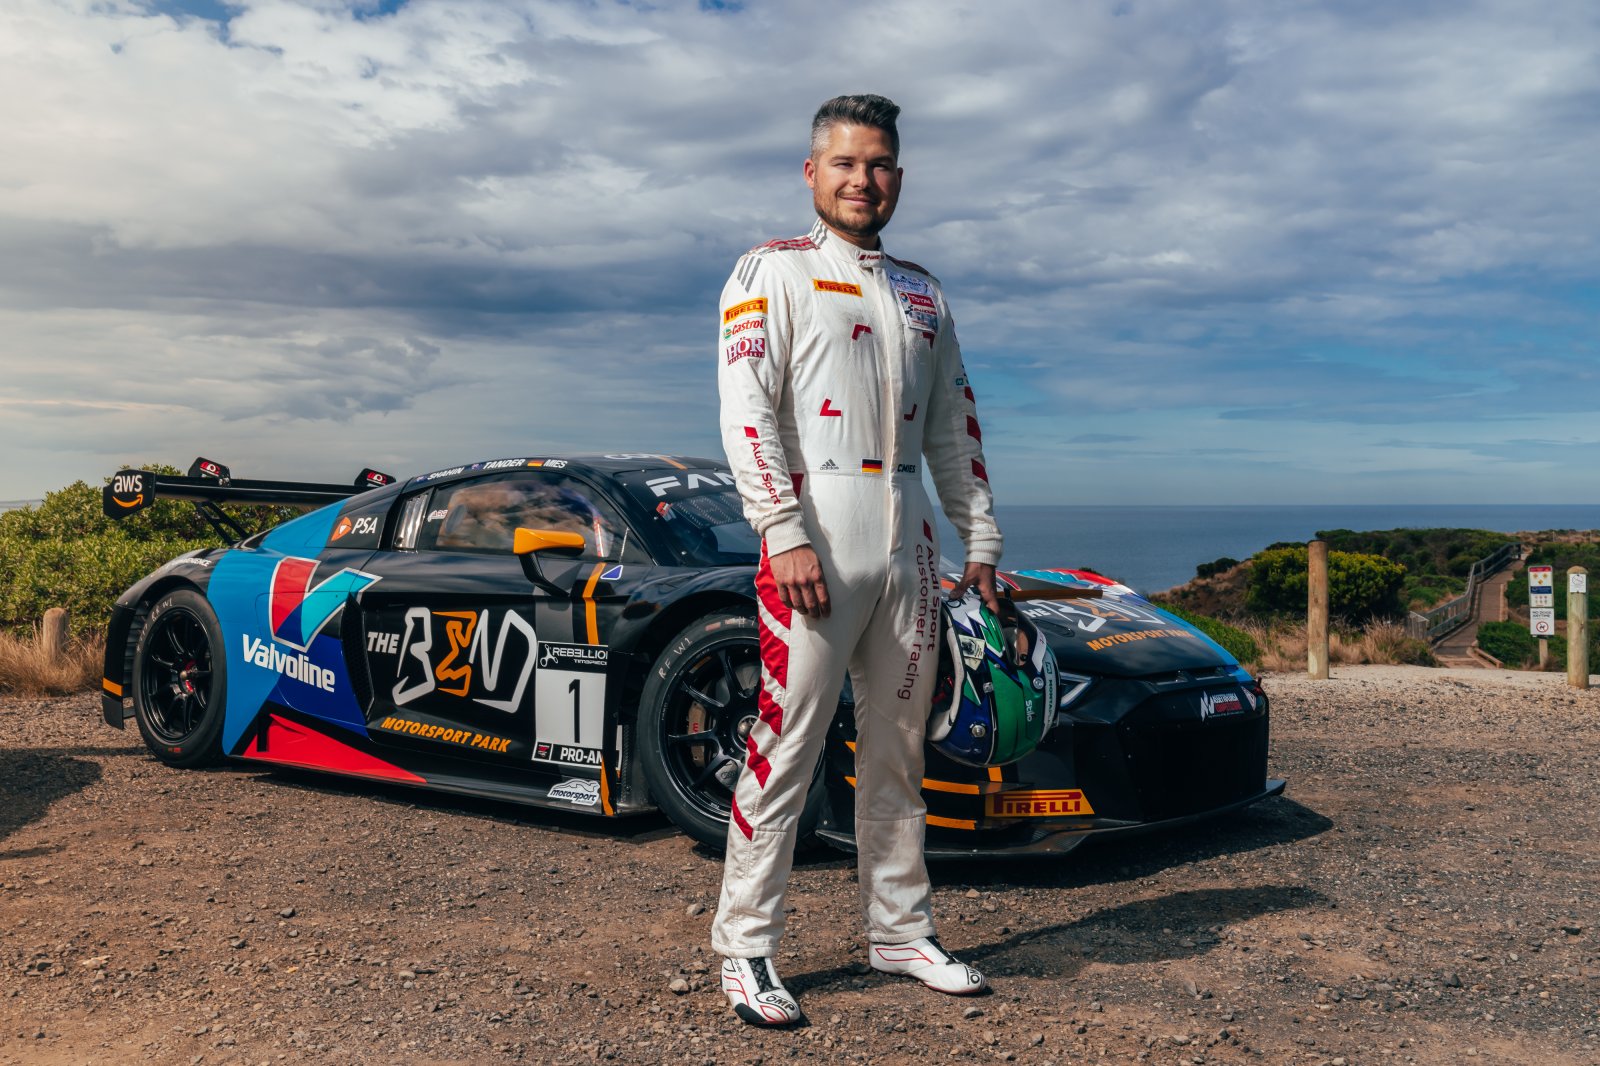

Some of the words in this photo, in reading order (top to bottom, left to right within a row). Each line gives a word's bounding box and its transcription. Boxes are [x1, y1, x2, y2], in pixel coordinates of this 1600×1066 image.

[817, 281, 858, 294] PIRELLI
[726, 299, 764, 320] PIRELLI
[732, 318, 765, 335] Castrol
[727, 336, 765, 361] HÖR
[427, 467, 464, 481] SHAHIN
[483, 458, 526, 470] TANDER
[543, 458, 568, 468] MIES
[750, 442, 768, 470] Audi
[762, 473, 782, 505] Sport
[114, 474, 143, 493] aws
[352, 517, 378, 534] PSA
[926, 545, 940, 590] Audi
[915, 544, 929, 638] customer
[927, 596, 940, 652] Sport
[1022, 607, 1051, 618] HE
[367, 631, 400, 655] THE
[1087, 629, 1168, 651] MOTORSPORT
[242, 633, 335, 693] Valvoline
[552, 646, 608, 660] REBELLIO
[897, 643, 922, 701] racing
[568, 678, 581, 744] 1
[1025, 699, 1033, 723] Stilo
[381, 716, 472, 745] MOTORSPORT
[471, 734, 512, 753] PARK
[550, 789, 597, 803] motorsport
[994, 791, 1082, 814] PIRELLI
[765, 995, 796, 1011] OMP
